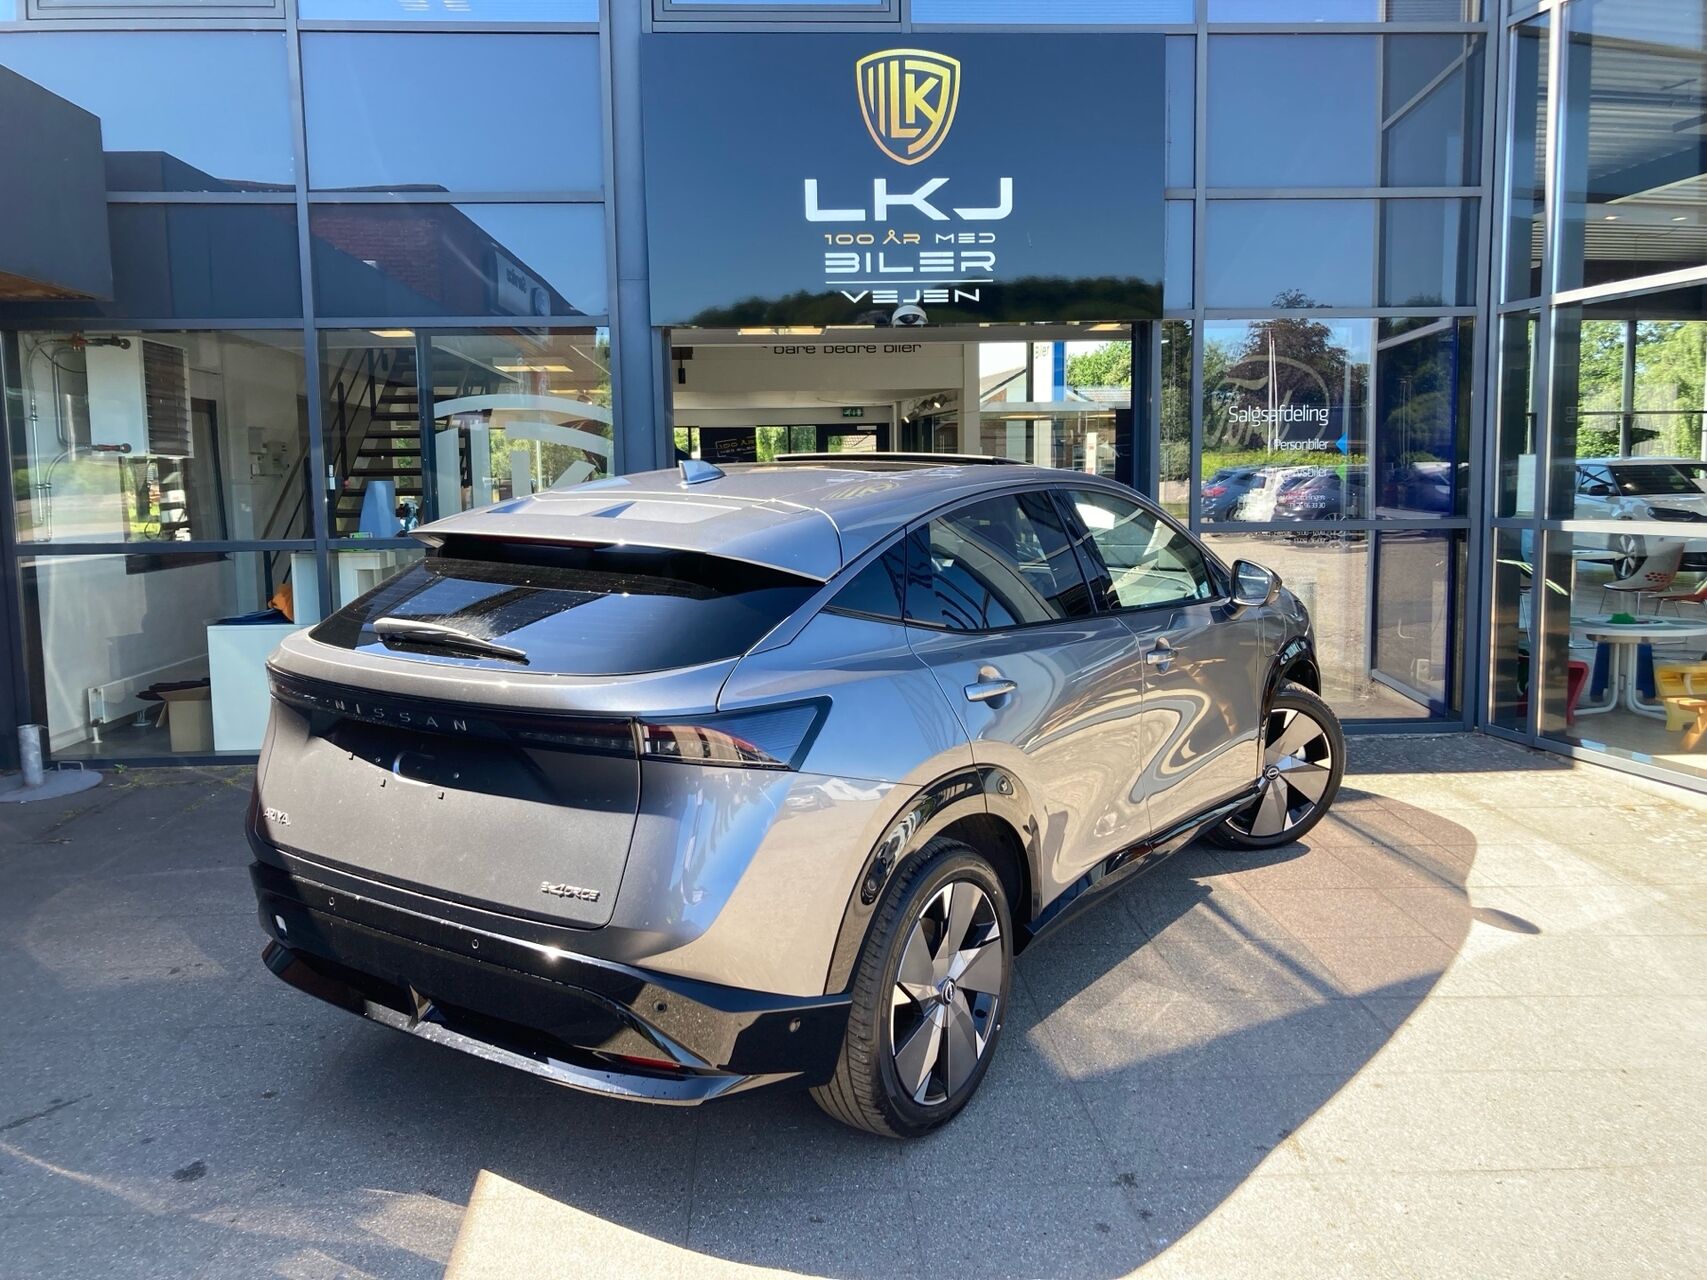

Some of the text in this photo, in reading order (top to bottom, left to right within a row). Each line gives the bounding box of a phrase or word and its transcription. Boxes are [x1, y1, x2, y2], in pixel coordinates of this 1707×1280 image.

[804, 177, 1013, 222] LKJ
[824, 229, 996, 245] 100 ÅR MED
[824, 250, 996, 273] BILER
[840, 288, 980, 304] VEJEN
[1228, 404, 1329, 427] Salgsafdeling
[1273, 438, 1329, 450] Personbiler
[335, 700, 467, 732] NISSAN
